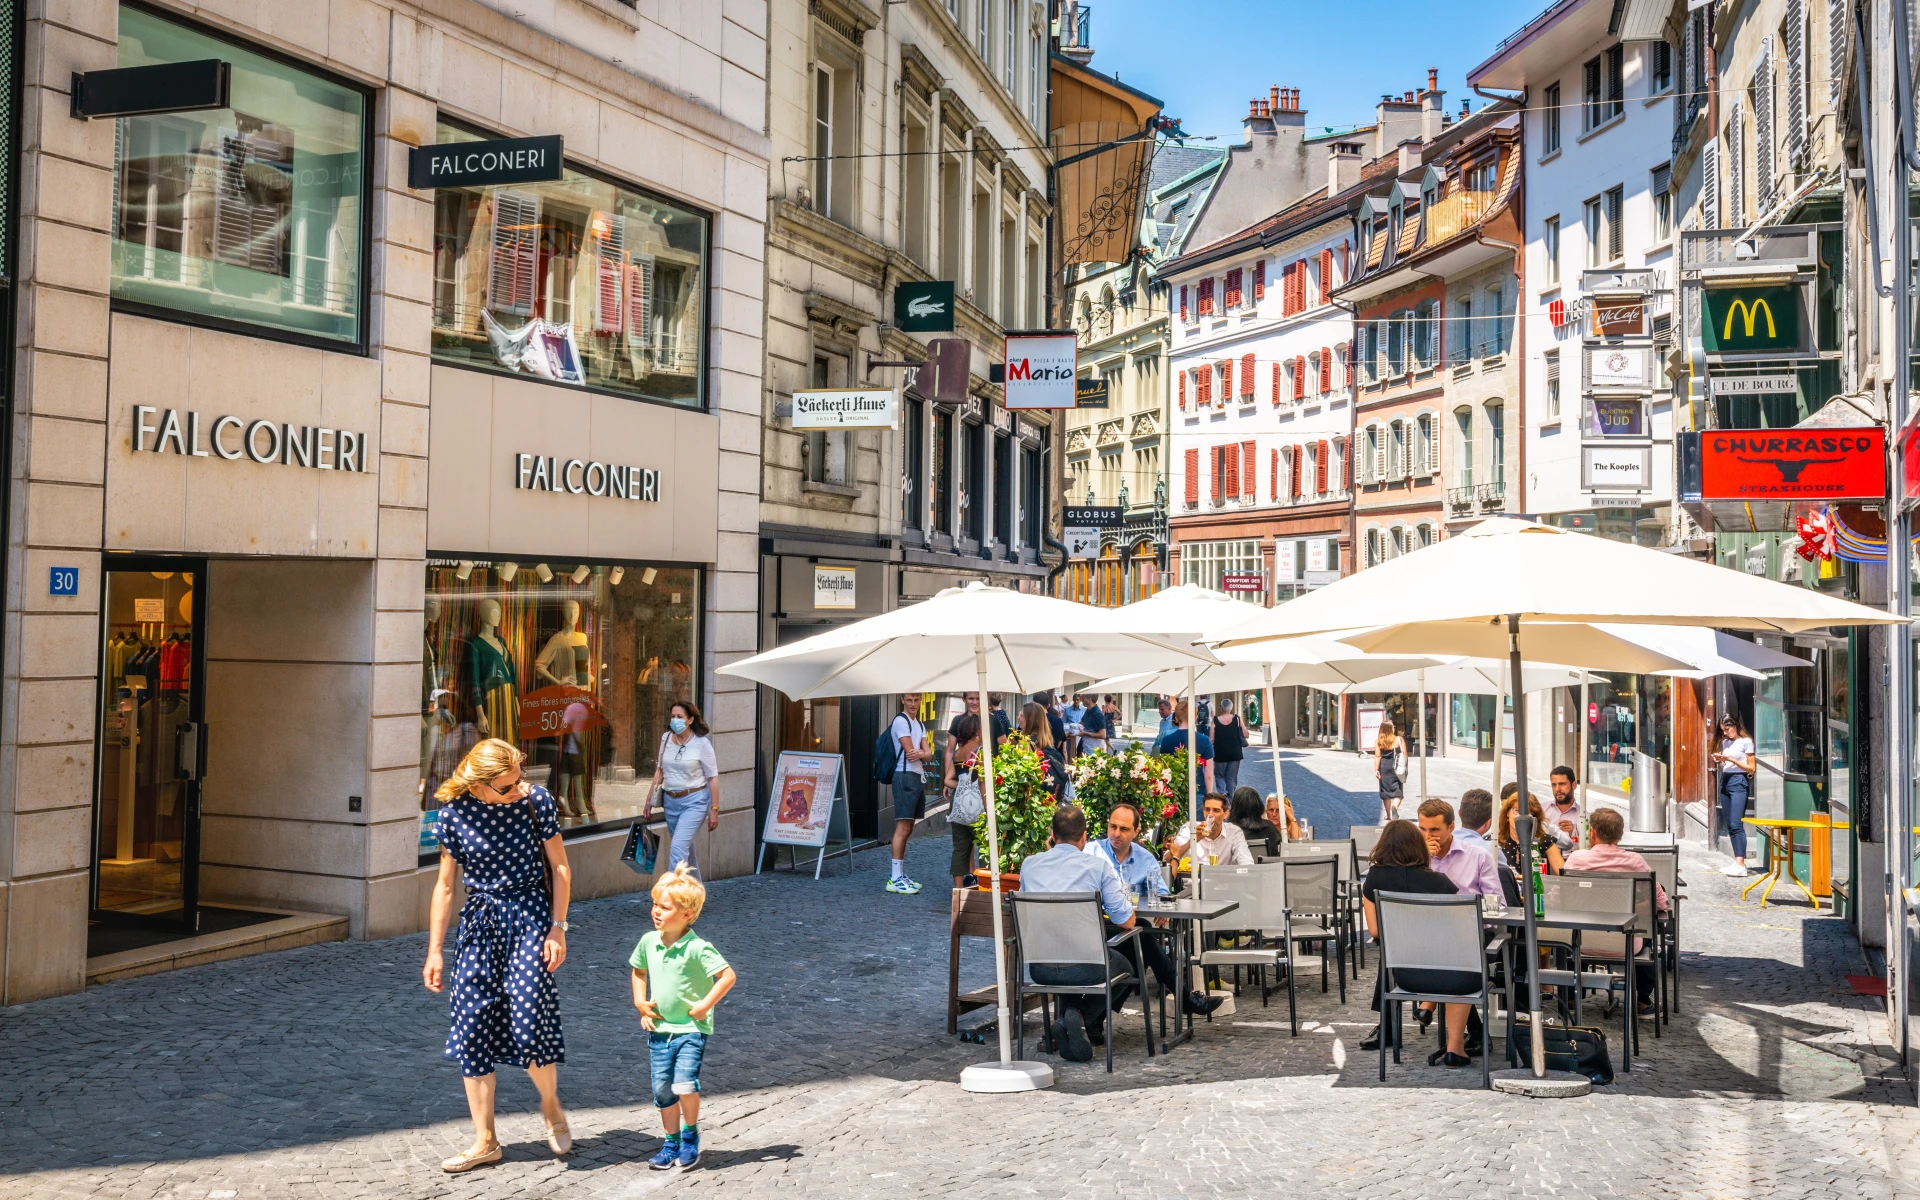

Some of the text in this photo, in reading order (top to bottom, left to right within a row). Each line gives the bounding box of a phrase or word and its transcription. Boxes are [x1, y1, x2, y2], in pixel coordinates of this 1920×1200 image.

[431, 149, 545, 175] FALCONERI
[1596, 305, 1640, 325] McCafé
[1008, 357, 1073, 381] Mario
[1732, 380, 1750, 391] DE
[1752, 378, 1794, 390] BOURG
[798, 395, 886, 413] Läckerli Huus
[132, 404, 368, 473] FALCONERI
[1713, 437, 1872, 453] CHURRASCO
[1609, 463, 1640, 471] Kooples
[515, 453, 661, 502] FALCONERI
[1739, 484, 1845, 492] STEAKHOUSE
[1067, 510, 1116, 518] GLOBUS
[54, 572, 74, 590] 30
[522, 699, 539, 708] Fines
[541, 697, 558, 707] fibres
